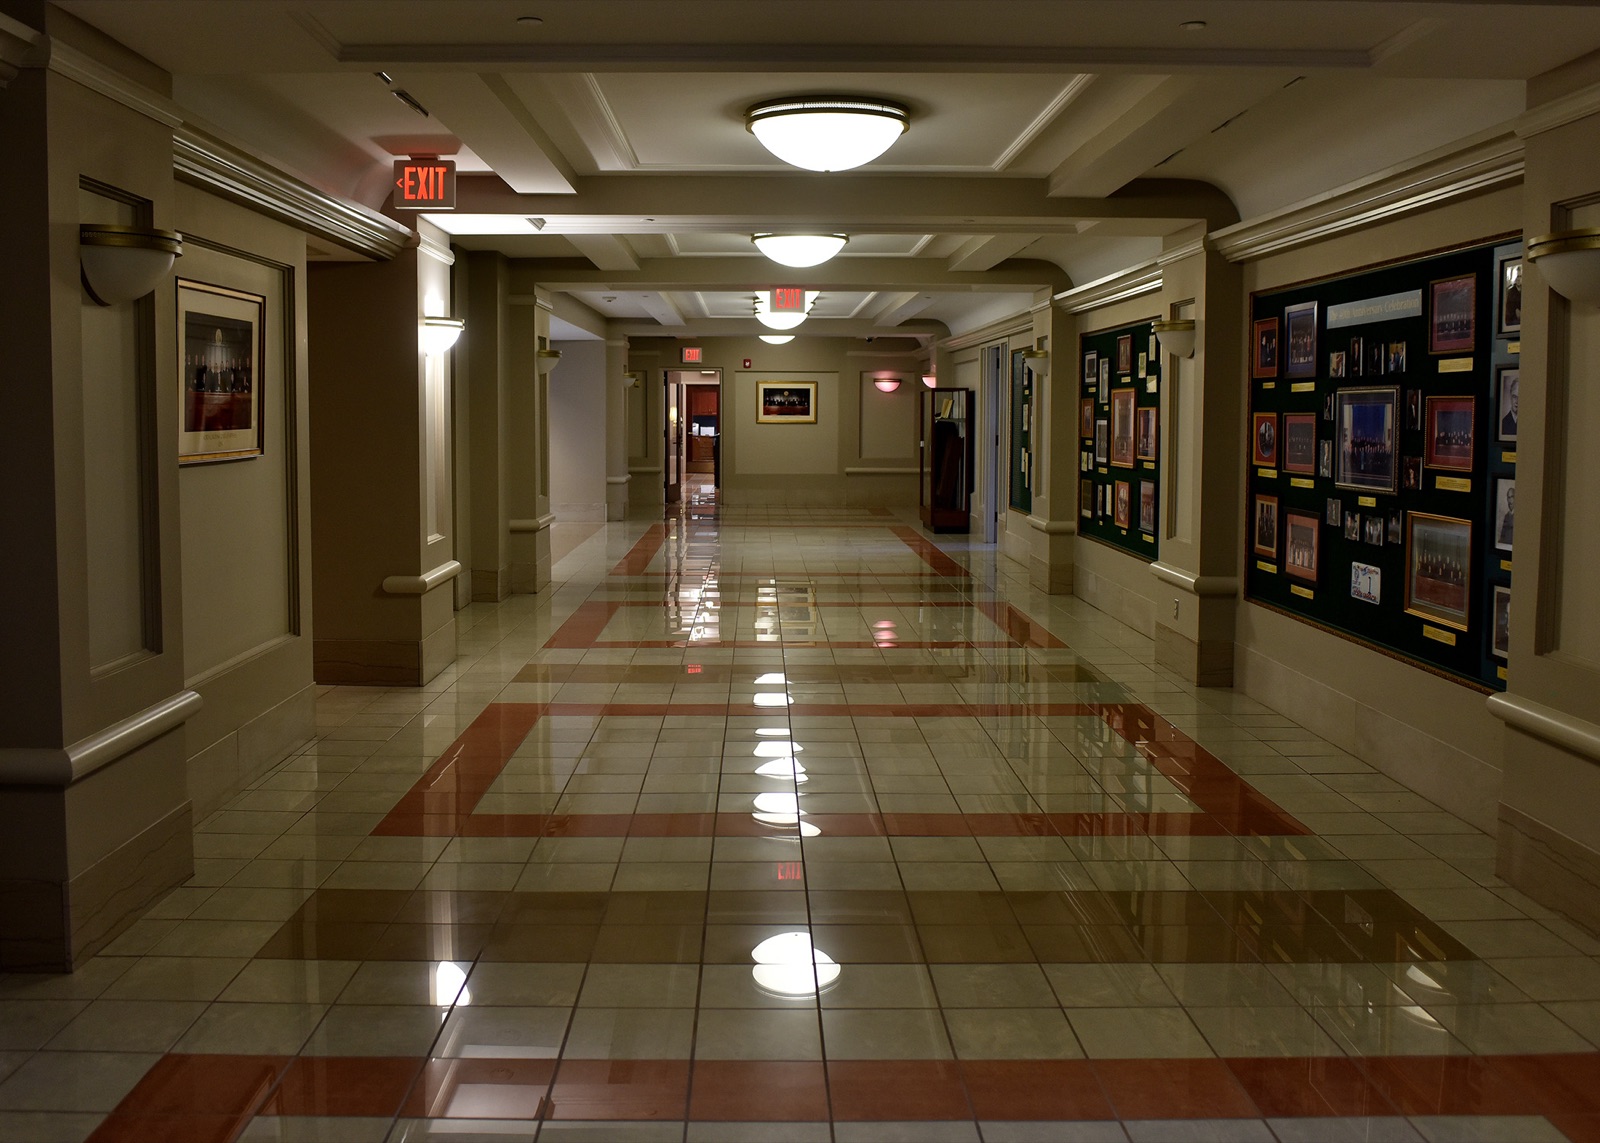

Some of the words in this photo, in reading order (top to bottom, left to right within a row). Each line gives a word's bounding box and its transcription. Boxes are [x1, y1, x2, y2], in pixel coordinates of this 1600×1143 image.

[404, 166, 447, 200] EXIT
[776, 288, 802, 309] EXIT
[685, 349, 700, 361] EXIT
